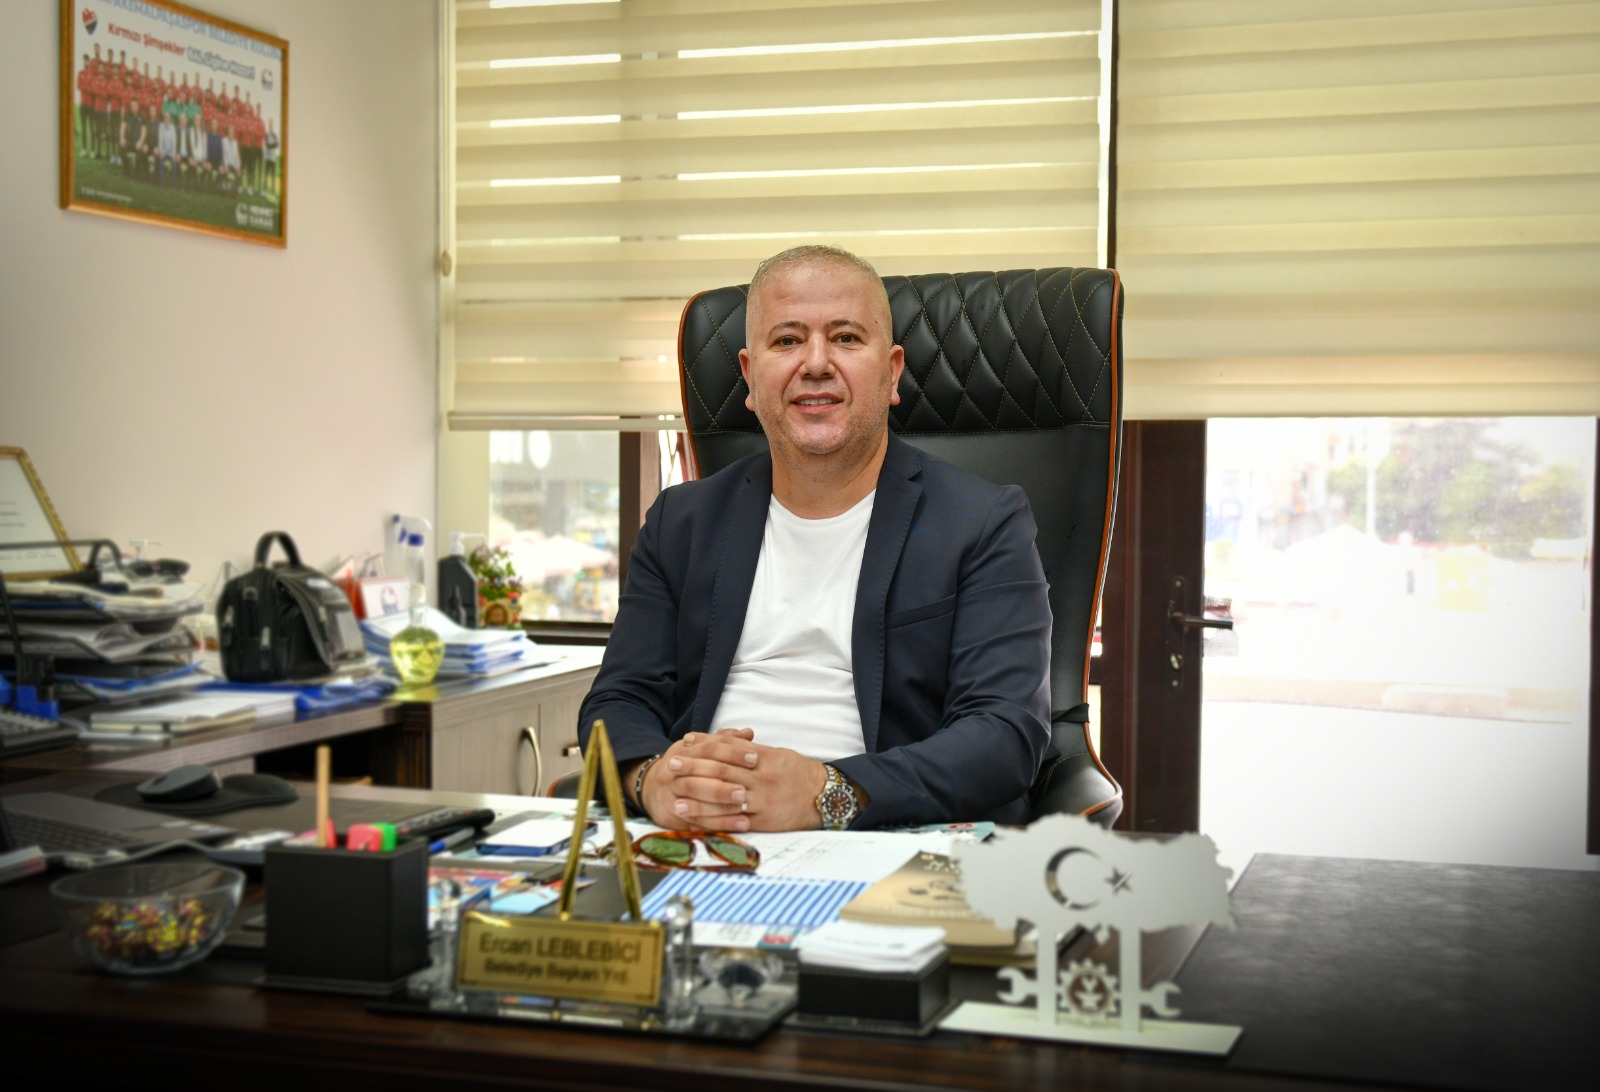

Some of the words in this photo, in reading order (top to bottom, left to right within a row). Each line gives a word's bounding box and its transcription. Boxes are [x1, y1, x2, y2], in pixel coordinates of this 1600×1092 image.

[108, 22, 141, 43] Kırmızı
[143, 33, 185, 56] Şimşekler
[479, 932, 533, 954] Ercan
[484, 958, 543, 980] Belediye
[546, 962, 599, 982] Başkan
